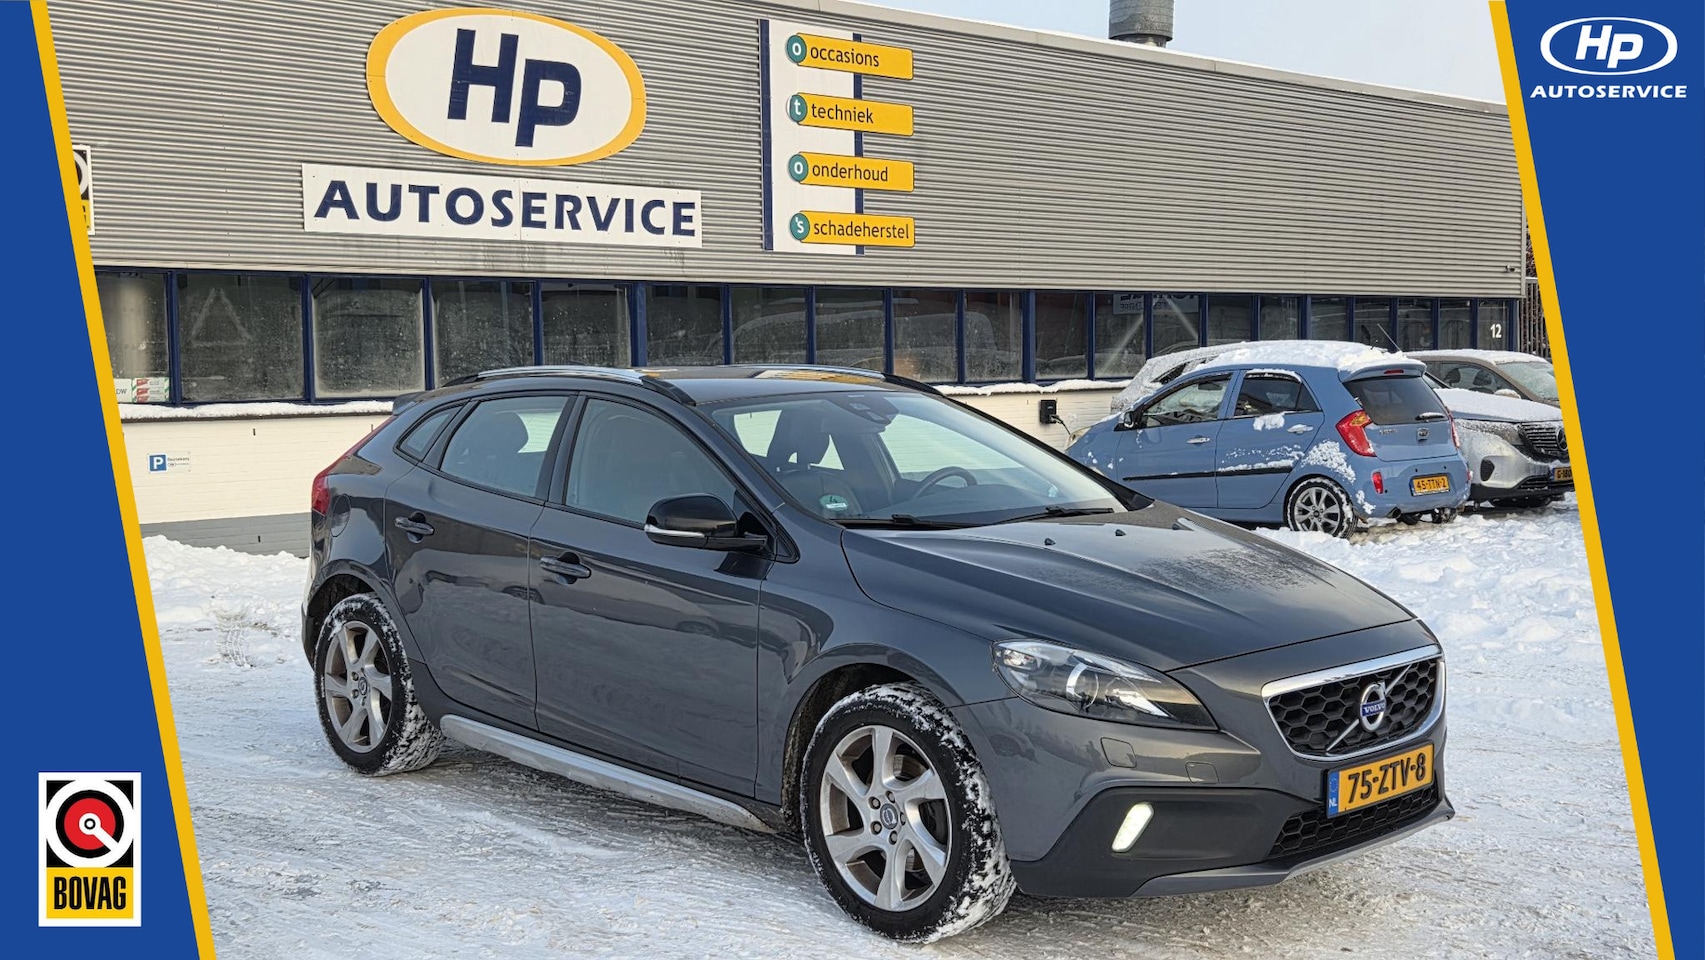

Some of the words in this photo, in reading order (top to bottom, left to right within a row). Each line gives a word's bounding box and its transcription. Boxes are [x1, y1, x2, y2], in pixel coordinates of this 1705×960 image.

[810, 47, 880, 67] occasions
[811, 103, 874, 124] techniek
[812, 162, 888, 182] onderhoud
[314, 180, 695, 237] AUTOSERVICE
[814, 220, 910, 239] schadeherstel
[1490, 323, 1502, 338] 12
[1364, 703, 1386, 713] VOLVO
[1348, 752, 1426, 804] 75-ZTV-8
[1328, 798, 1337, 807] NL
